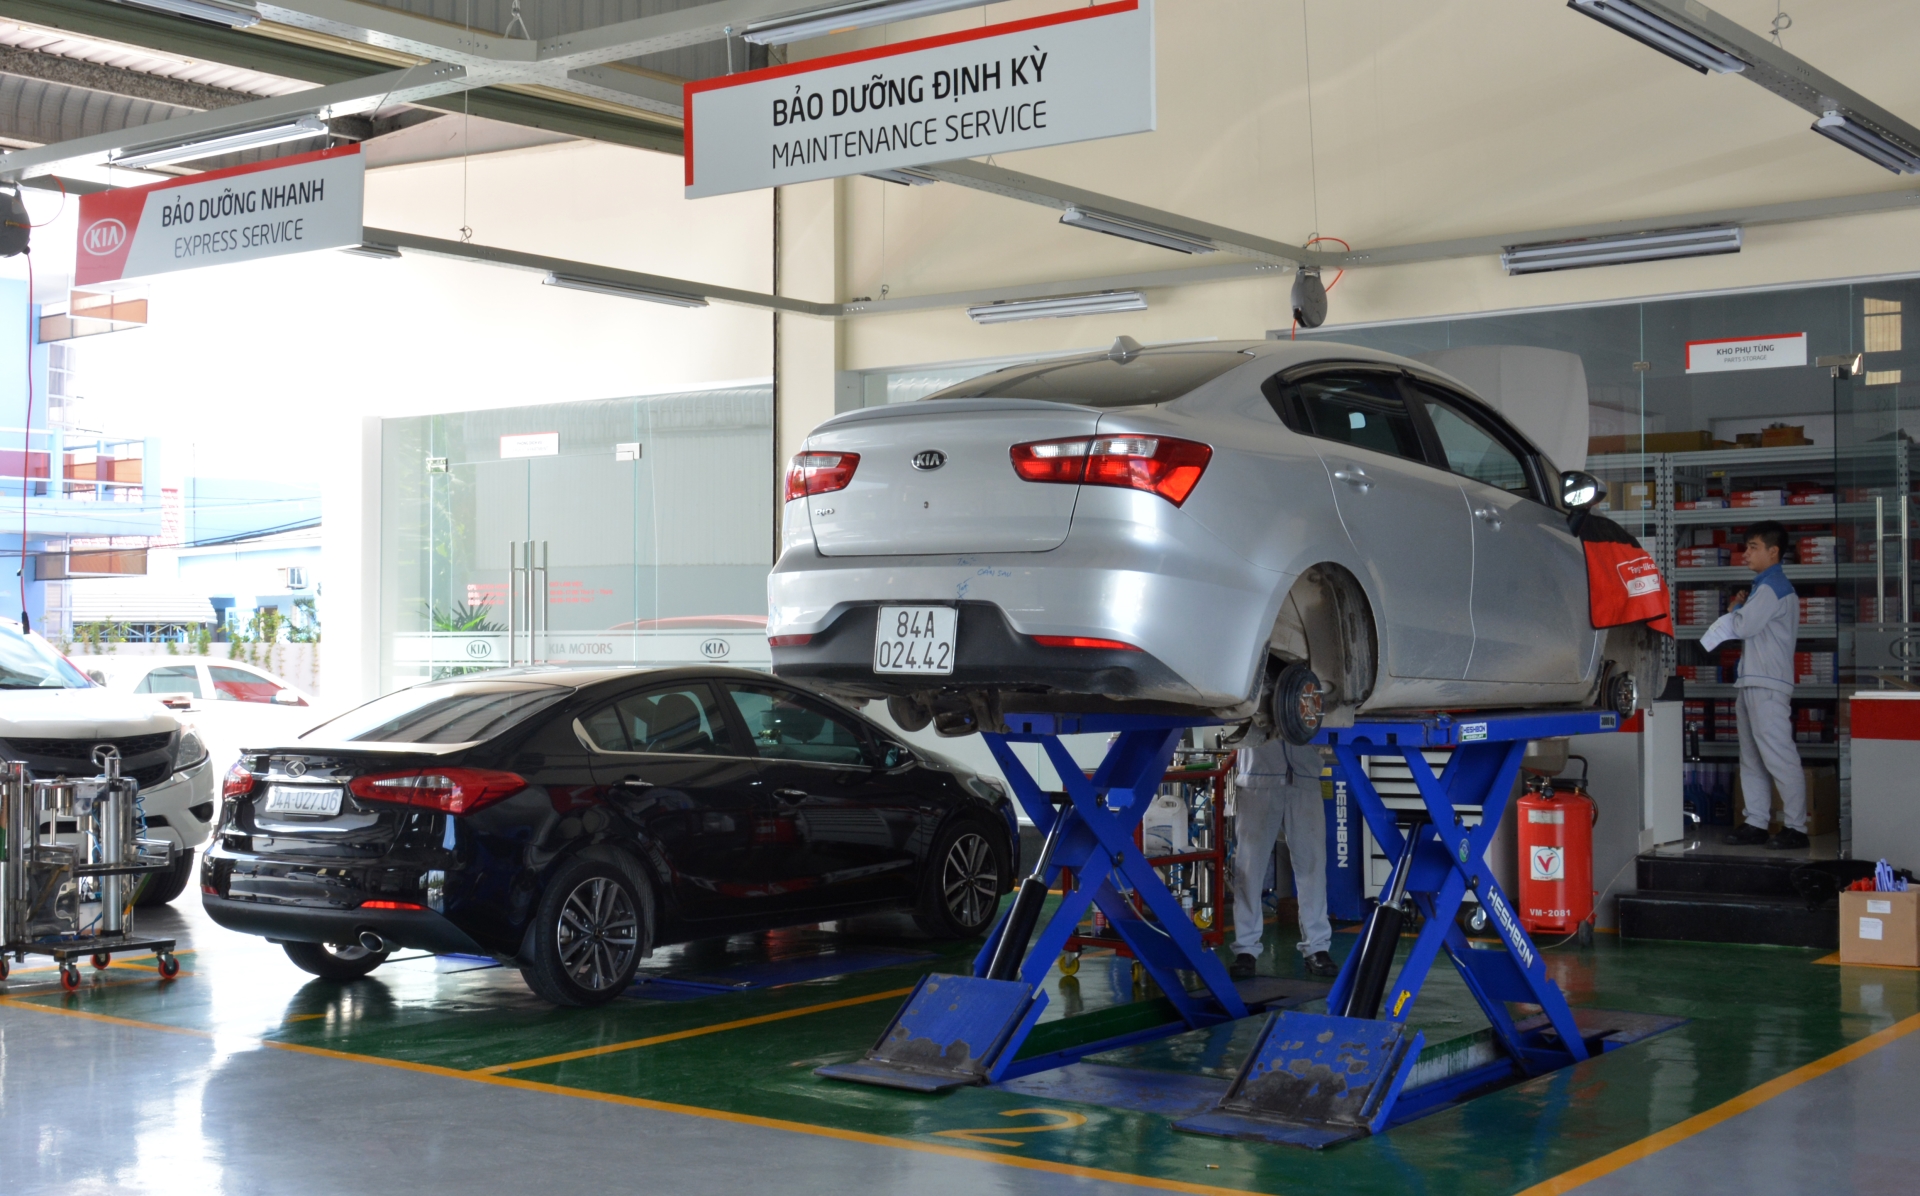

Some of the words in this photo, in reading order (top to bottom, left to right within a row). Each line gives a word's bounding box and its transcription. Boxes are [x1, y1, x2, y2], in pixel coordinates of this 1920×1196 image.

[773, 85, 824, 127] BẢO
[832, 73, 924, 117] DƯỠNG
[932, 60, 1001, 103] ĐỊNH
[1011, 45, 1048, 87] KỲ
[772, 118, 937, 169] MAINTENANCE
[945, 100, 1047, 142] SERVICE
[161, 195, 194, 228] BẢO
[199, 188, 256, 221] DƯỠNG
[261, 178, 325, 211] NHANH
[90, 225, 119, 249] KIA
[174, 228, 238, 259] EXPRESS
[242, 218, 303, 249] SERVICE
[1716, 347, 1733, 356] KHO
[1735, 346, 1752, 355] PHỤ
[1753, 344, 1775, 353] TÙNG
[1743, 354, 1767, 362] STORAGE
[916, 453, 940, 466] KIA
[896, 610, 935, 638] 84A
[470, 644, 487, 654] KIA
[549, 643, 566, 655] KIA
[568, 643, 613, 655] MOTORS
[705, 643, 725, 654] KIA
[879, 641, 950, 670] 024.42
[1899, 642, 1920, 657] KI
[1335, 781, 1348, 868] HESHBON
[1529, 908, 1571, 917] VM-2081
[1486, 885, 1534, 969] HESHBON
[930, 1108, 1088, 1148] 2
